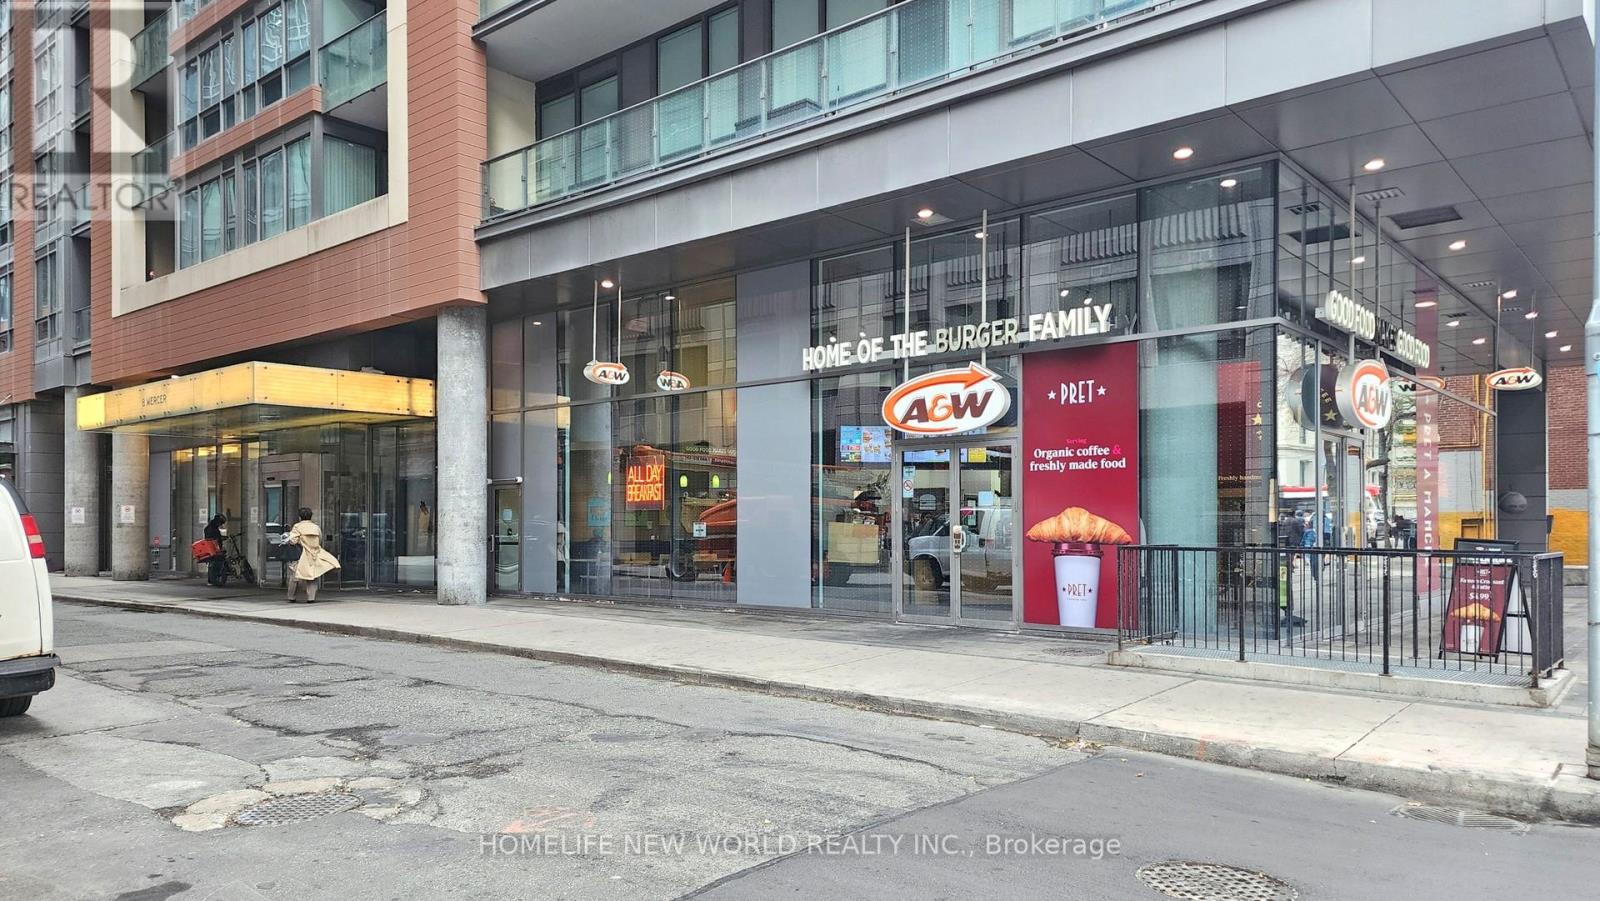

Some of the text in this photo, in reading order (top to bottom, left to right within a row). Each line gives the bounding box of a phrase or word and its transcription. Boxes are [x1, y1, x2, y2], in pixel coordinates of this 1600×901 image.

[802, 303, 1112, 371] HOME OF THE BURGER FAMILY
[1494, 374, 1536, 386] A&W
[1060, 379, 1095, 405] PRET
[1359, 382, 1389, 418] A&W
[899, 388, 995, 424] A&W
[1033, 445, 1122, 461] Organic coffee &
[628, 464, 664, 483] ALL DAY
[1029, 457, 1127, 473] freshly made food
[1067, 583, 1087, 596] PRET
